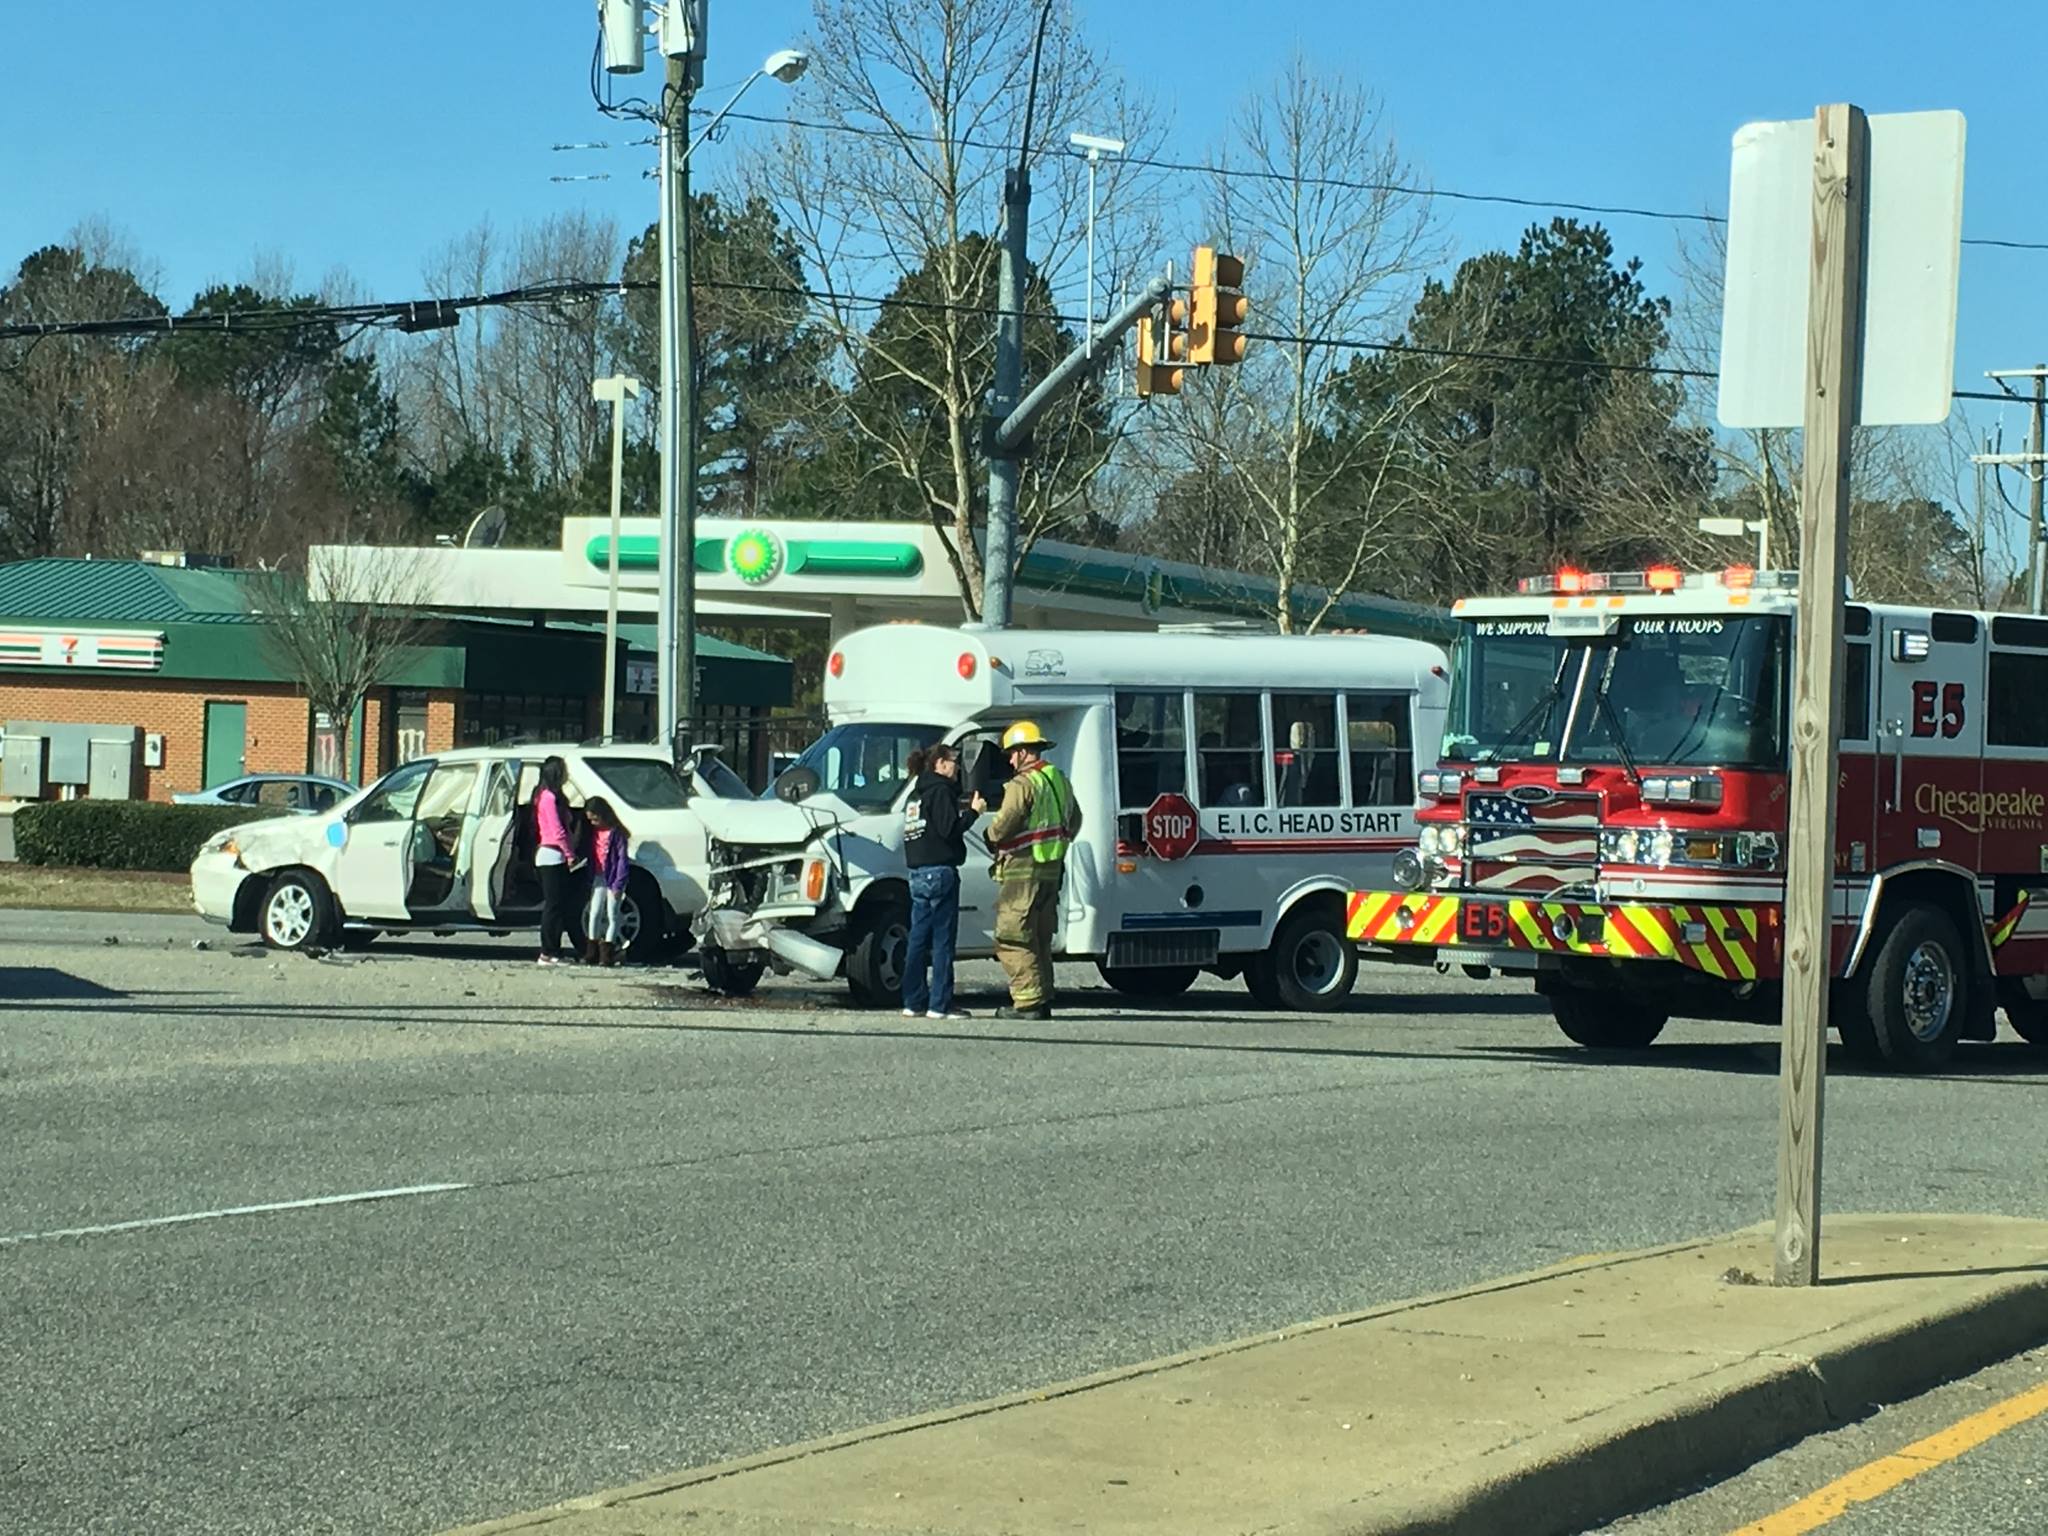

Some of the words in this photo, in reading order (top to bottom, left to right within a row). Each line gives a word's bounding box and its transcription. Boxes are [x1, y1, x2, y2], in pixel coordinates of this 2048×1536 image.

[1476, 622, 1494, 636] WE
[1633, 620, 1665, 634] OUR
[1668, 619, 1724, 634] TROOPS
[1911, 680, 1966, 739] E5
[1915, 783, 2045, 831] Chesapeake
[1152, 815, 1192, 839] STOP
[1279, 814, 1334, 833] HEAD
[1340, 813, 1402, 833] START
[1986, 817, 2042, 830] VIRGINIA
[1465, 902, 1504, 937] E5
